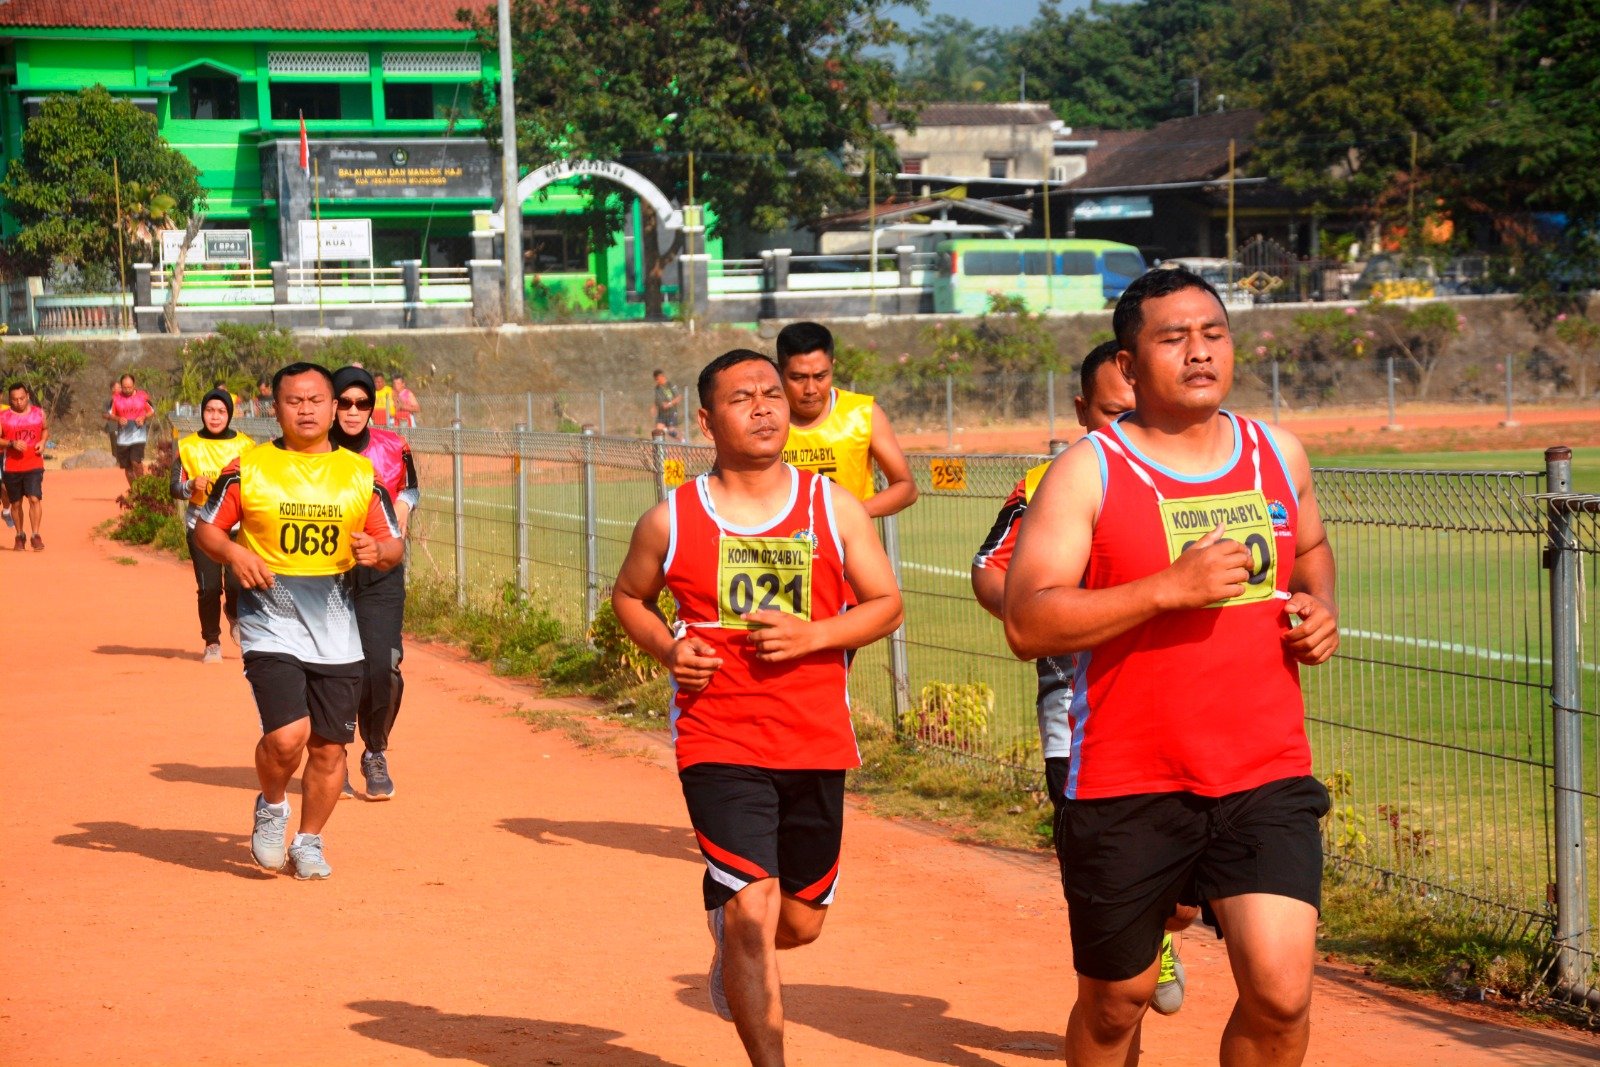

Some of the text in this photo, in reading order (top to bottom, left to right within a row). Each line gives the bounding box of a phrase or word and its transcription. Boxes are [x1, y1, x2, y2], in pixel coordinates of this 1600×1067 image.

[338, 168, 463, 177] BALAI NIKAH DAN MANASIK HAJI
[280, 502, 306, 516] KODIM
[1172, 504, 1263, 529] KODIM 0724/BYL
[280, 522, 340, 556] 068
[727, 548, 804, 565] KODIM 0724/BYL
[729, 572, 803, 616] 021
